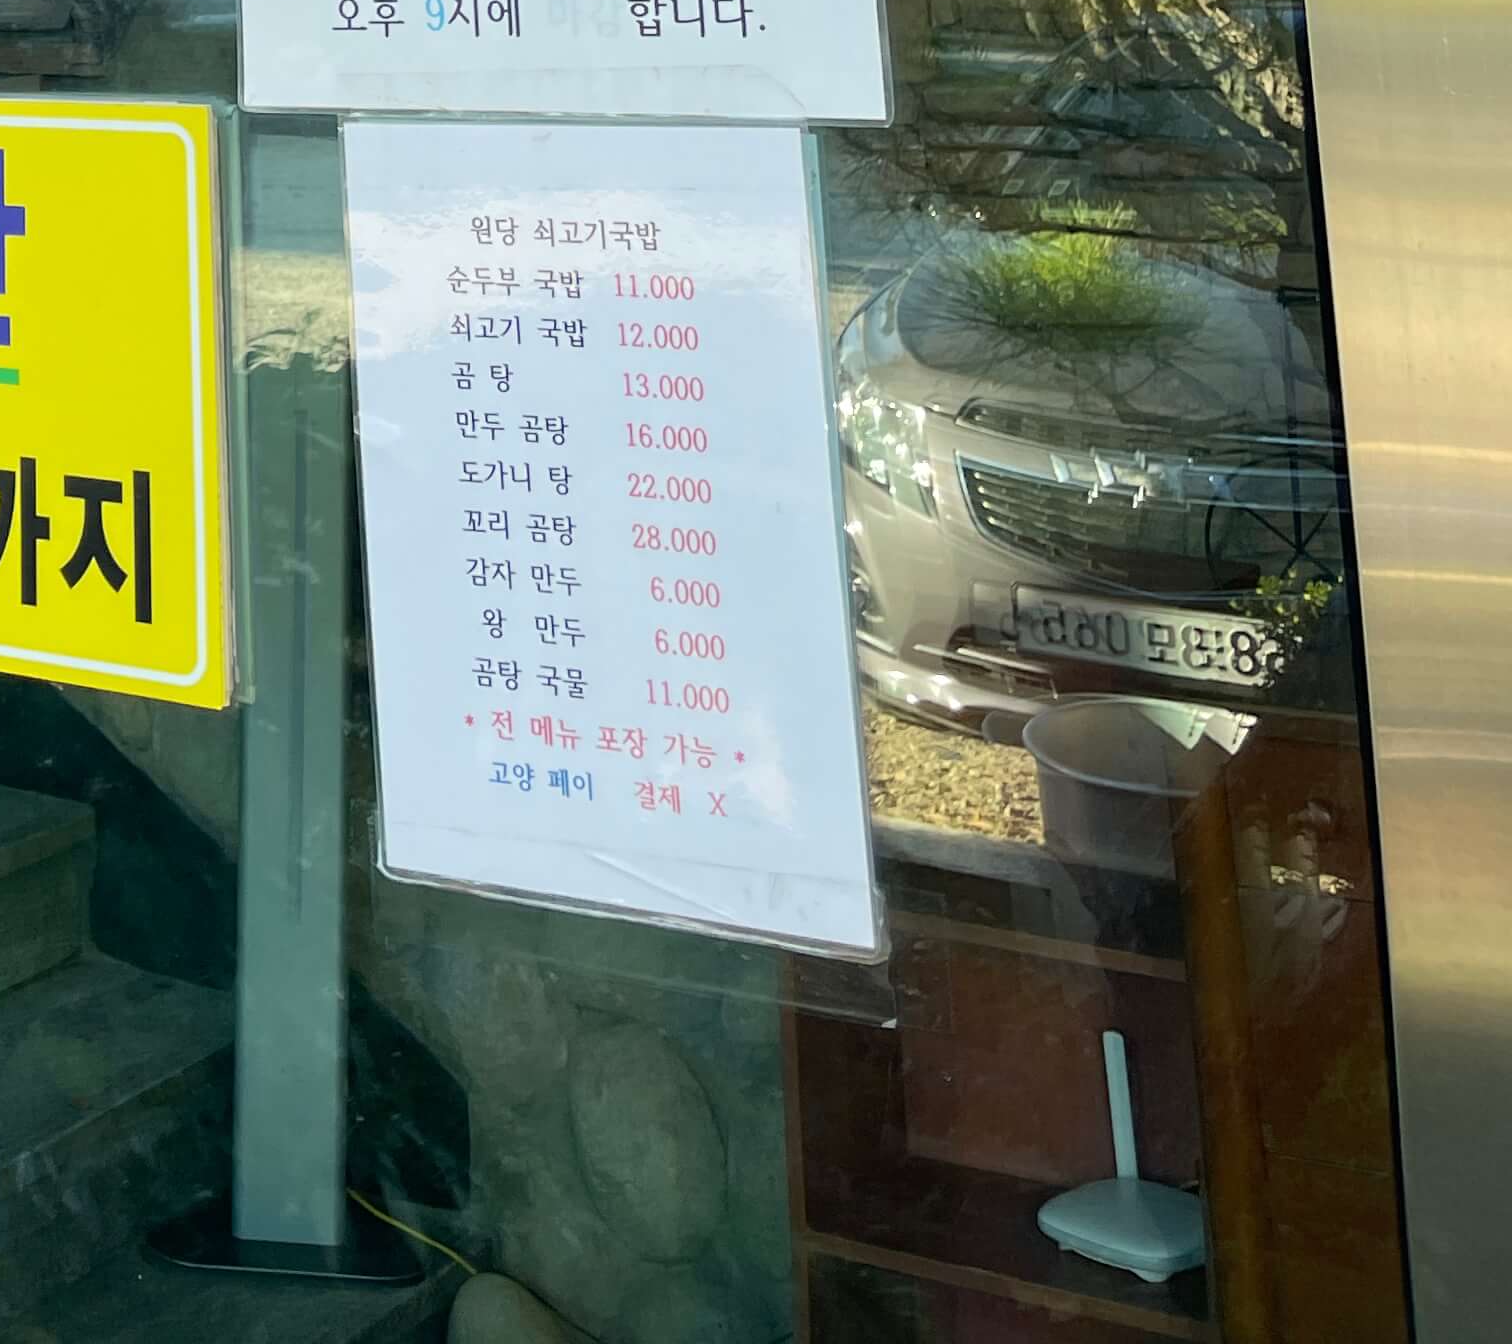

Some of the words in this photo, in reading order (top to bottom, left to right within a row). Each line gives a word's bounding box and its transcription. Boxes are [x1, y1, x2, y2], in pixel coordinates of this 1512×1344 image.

[470, 215, 520, 247] 원당
[532, 218, 662, 252] 쇠고기국밥
[446, 265, 521, 299] 순두부
[533, 268, 585, 301] 국밥
[613, 271, 696, 302] 11.000
[449, 312, 523, 345] 쇠고기
[536, 317, 588, 348] 국밥
[617, 321, 700, 352] 12.000
[622, 371, 705, 403] 13.000
[455, 408, 506, 442] 만두
[518, 413, 570, 447] 곰탕
[625, 421, 709, 454] 16.000
[458, 459, 533, 493] 도가니
[547, 464, 574, 497] 탕
[627, 471, 713, 505] 22.000
[461, 509, 511, 541] 꼬리
[524, 512, 578, 547] 곰탕
[631, 522, 718, 557] 28.000
[465, 556, 518, 591] 감자
[529, 561, 583, 597] 만두
[649, 575, 722, 609] 6.000
[481, 607, 508, 640] 왕
[534, 613, 587, 648] 만두
[654, 627, 727, 662] 6.000
[471, 655, 524, 692] 곰탕
[535, 663, 589, 700] 국물
[645, 677, 731, 714] 11.000
[490, 709, 515, 742] 전
[529, 714, 583, 751] 메뉴
[595, 724, 649, 760] 포장
[662, 733, 718, 770] 가능
[487, 761, 536, 792] 고양
[548, 767, 596, 802] 페이
[632, 780, 682, 816] 결제
